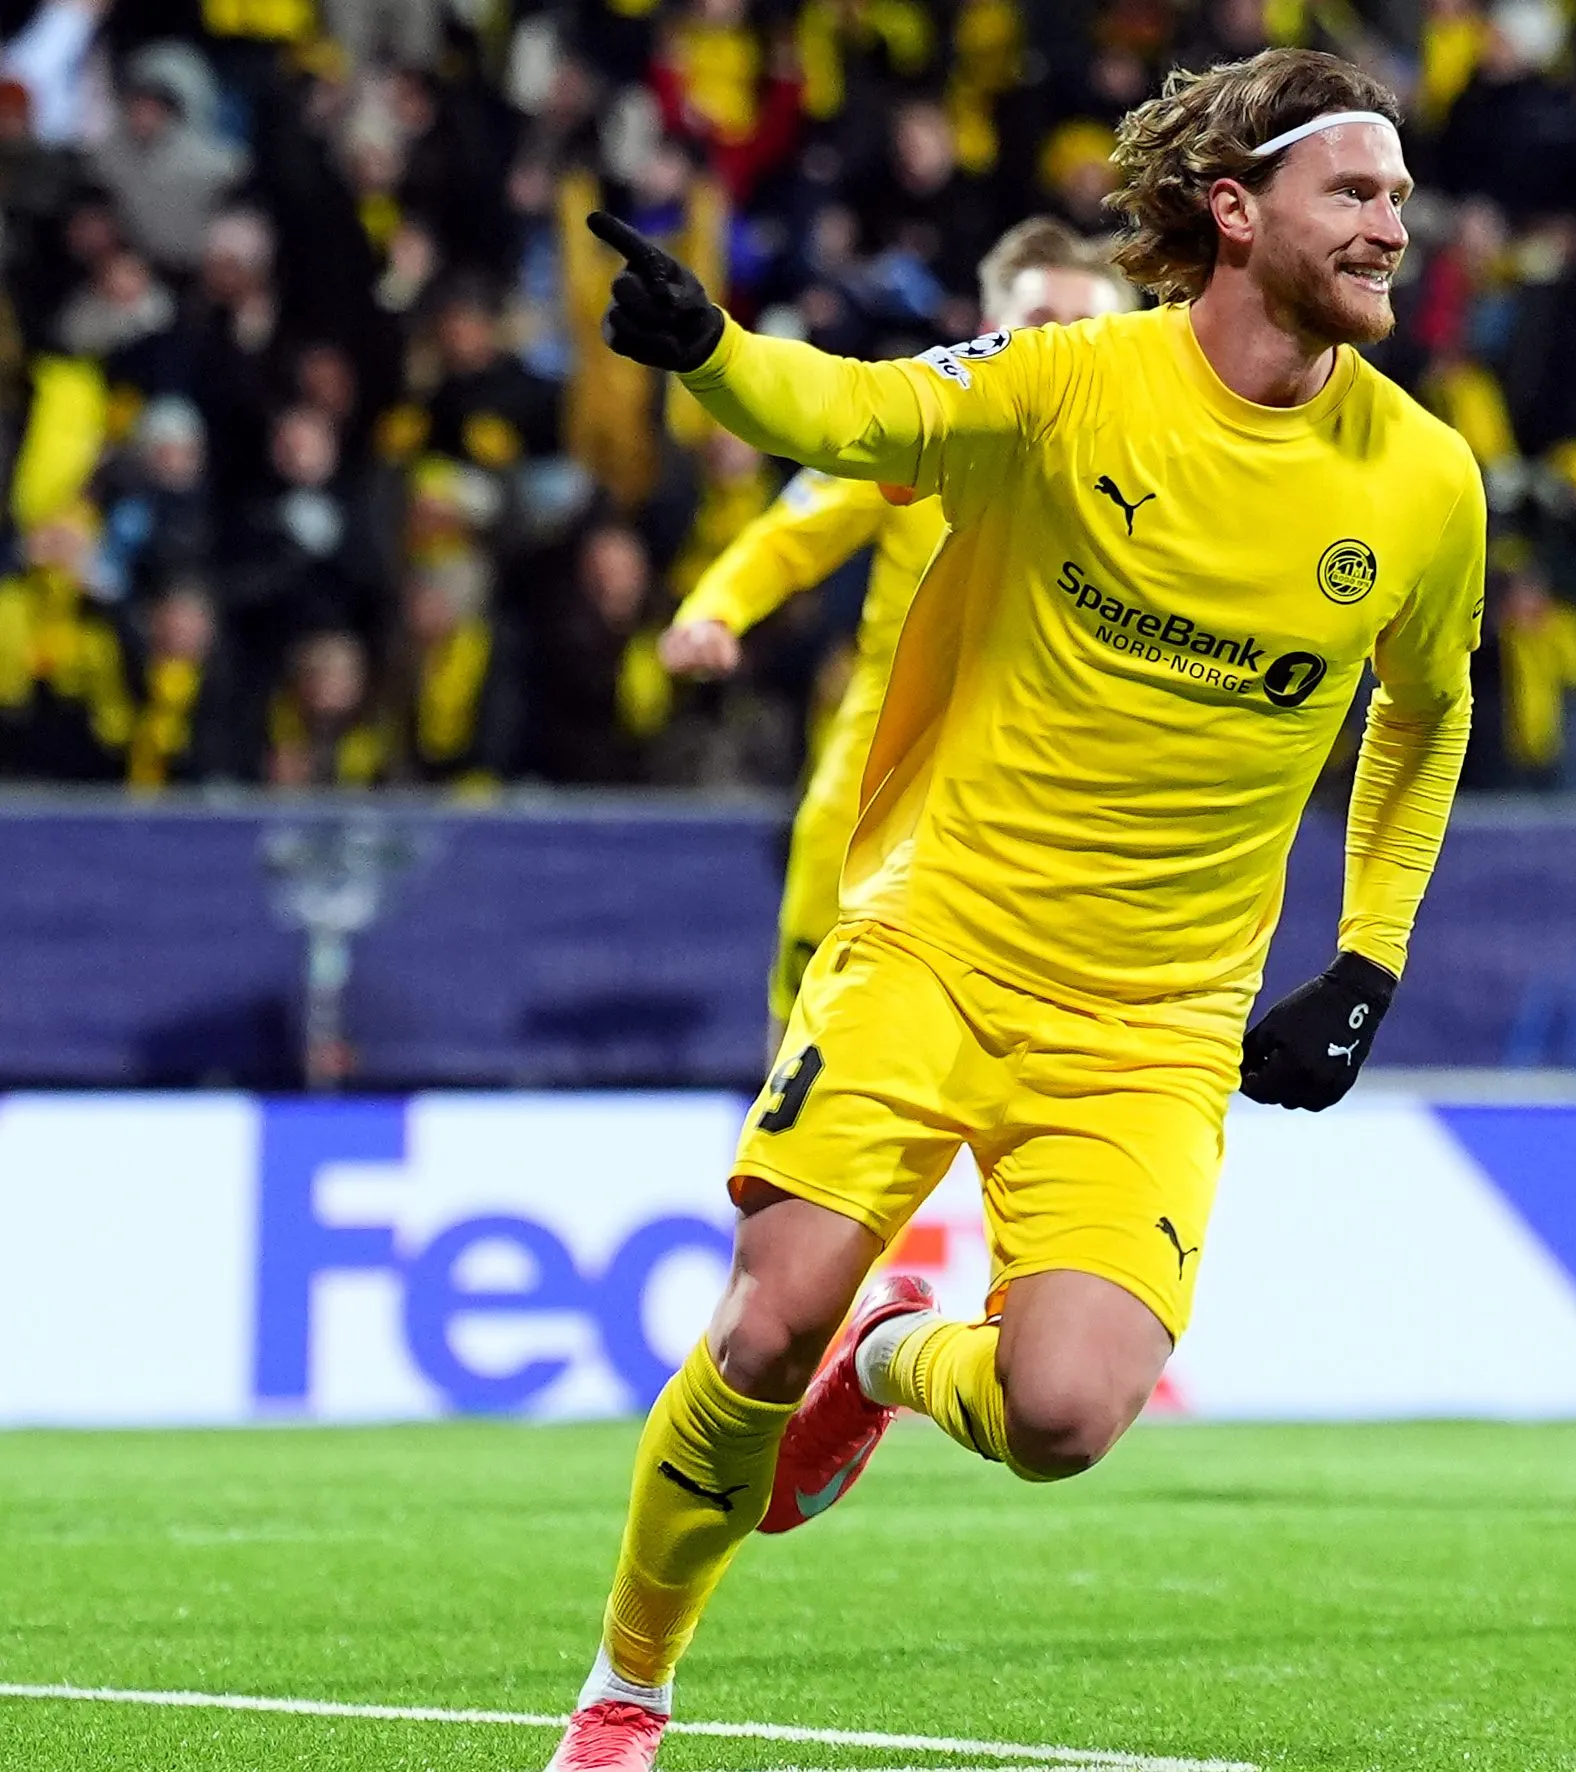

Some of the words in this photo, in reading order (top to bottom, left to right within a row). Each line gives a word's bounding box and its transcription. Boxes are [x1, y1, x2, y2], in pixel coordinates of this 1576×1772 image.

[1056, 560, 1265, 672] SpareBank
[1095, 625, 1252, 694] NORD-NORGE
[1349, 1003, 1369, 1029] 6
[756, 1044, 825, 1135] 9
